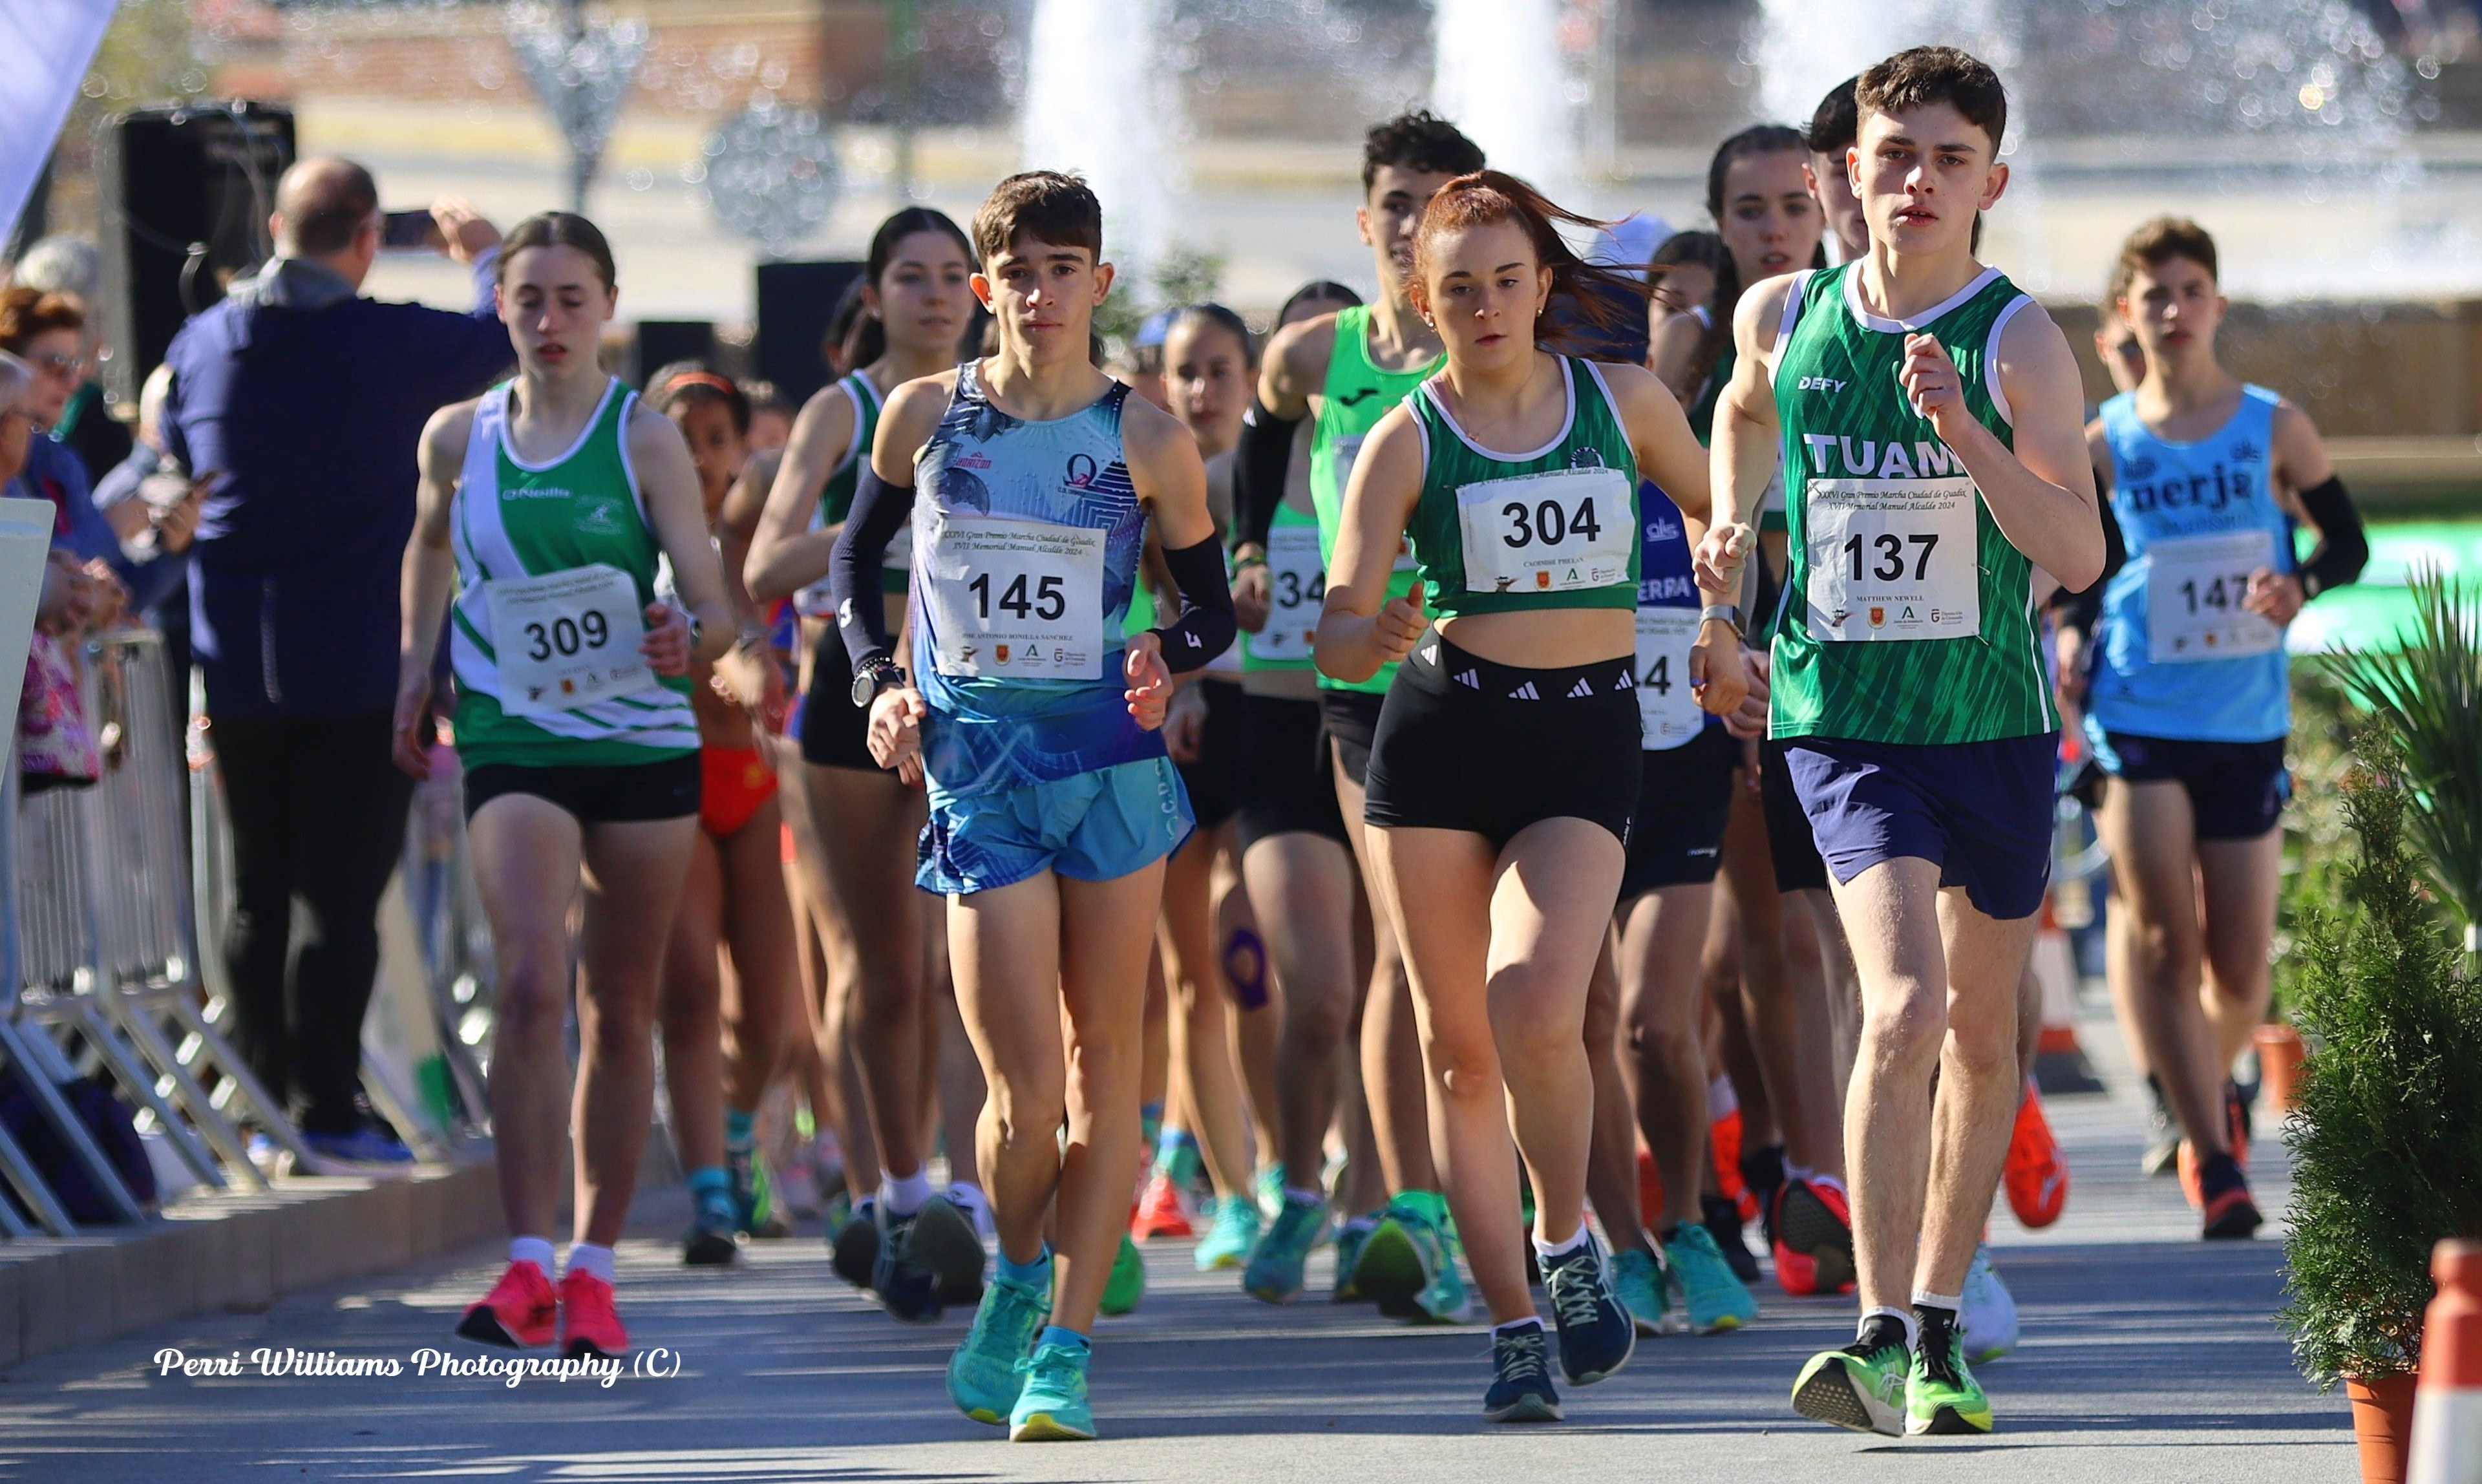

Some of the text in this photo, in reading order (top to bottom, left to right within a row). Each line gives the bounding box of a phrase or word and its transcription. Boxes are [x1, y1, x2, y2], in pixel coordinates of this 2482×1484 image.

[1798, 376, 1847, 393] DEFY
[957, 458, 992, 470] HORIZON
[1803, 433, 1966, 479] TUAM
[1841, 491, 1855, 500] Gran
[1856, 491, 1878, 499] Premio
[1880, 491, 1906, 499] Marcha
[1908, 490, 1933, 499] Ciudad
[1933, 490, 1942, 498] de
[1943, 489, 1967, 500] Guadix
[1846, 502, 1878, 511] Memorial
[1879, 502, 1907, 511] Manuel
[1908, 502, 1936, 511] Alcalde
[2134, 463, 2252, 513] nerja
[966, 531, 982, 540] Gran
[1009, 533, 1034, 541] Marcha
[1035, 533, 1060, 542] Ciudad
[1061, 535, 1068, 543] de
[1502, 497, 1600, 548] 304
[971, 542, 1006, 550] Memorial
[1008, 543, 1034, 552] Manuel
[1035, 545, 1062, 554] Alcalde
[1064, 547, 1083, 556] 2024
[1844, 534, 1938, 581] 137
[969, 573, 1065, 620] 145
[524, 610, 609, 662] 309
[1635, 656, 1671, 695] 4
